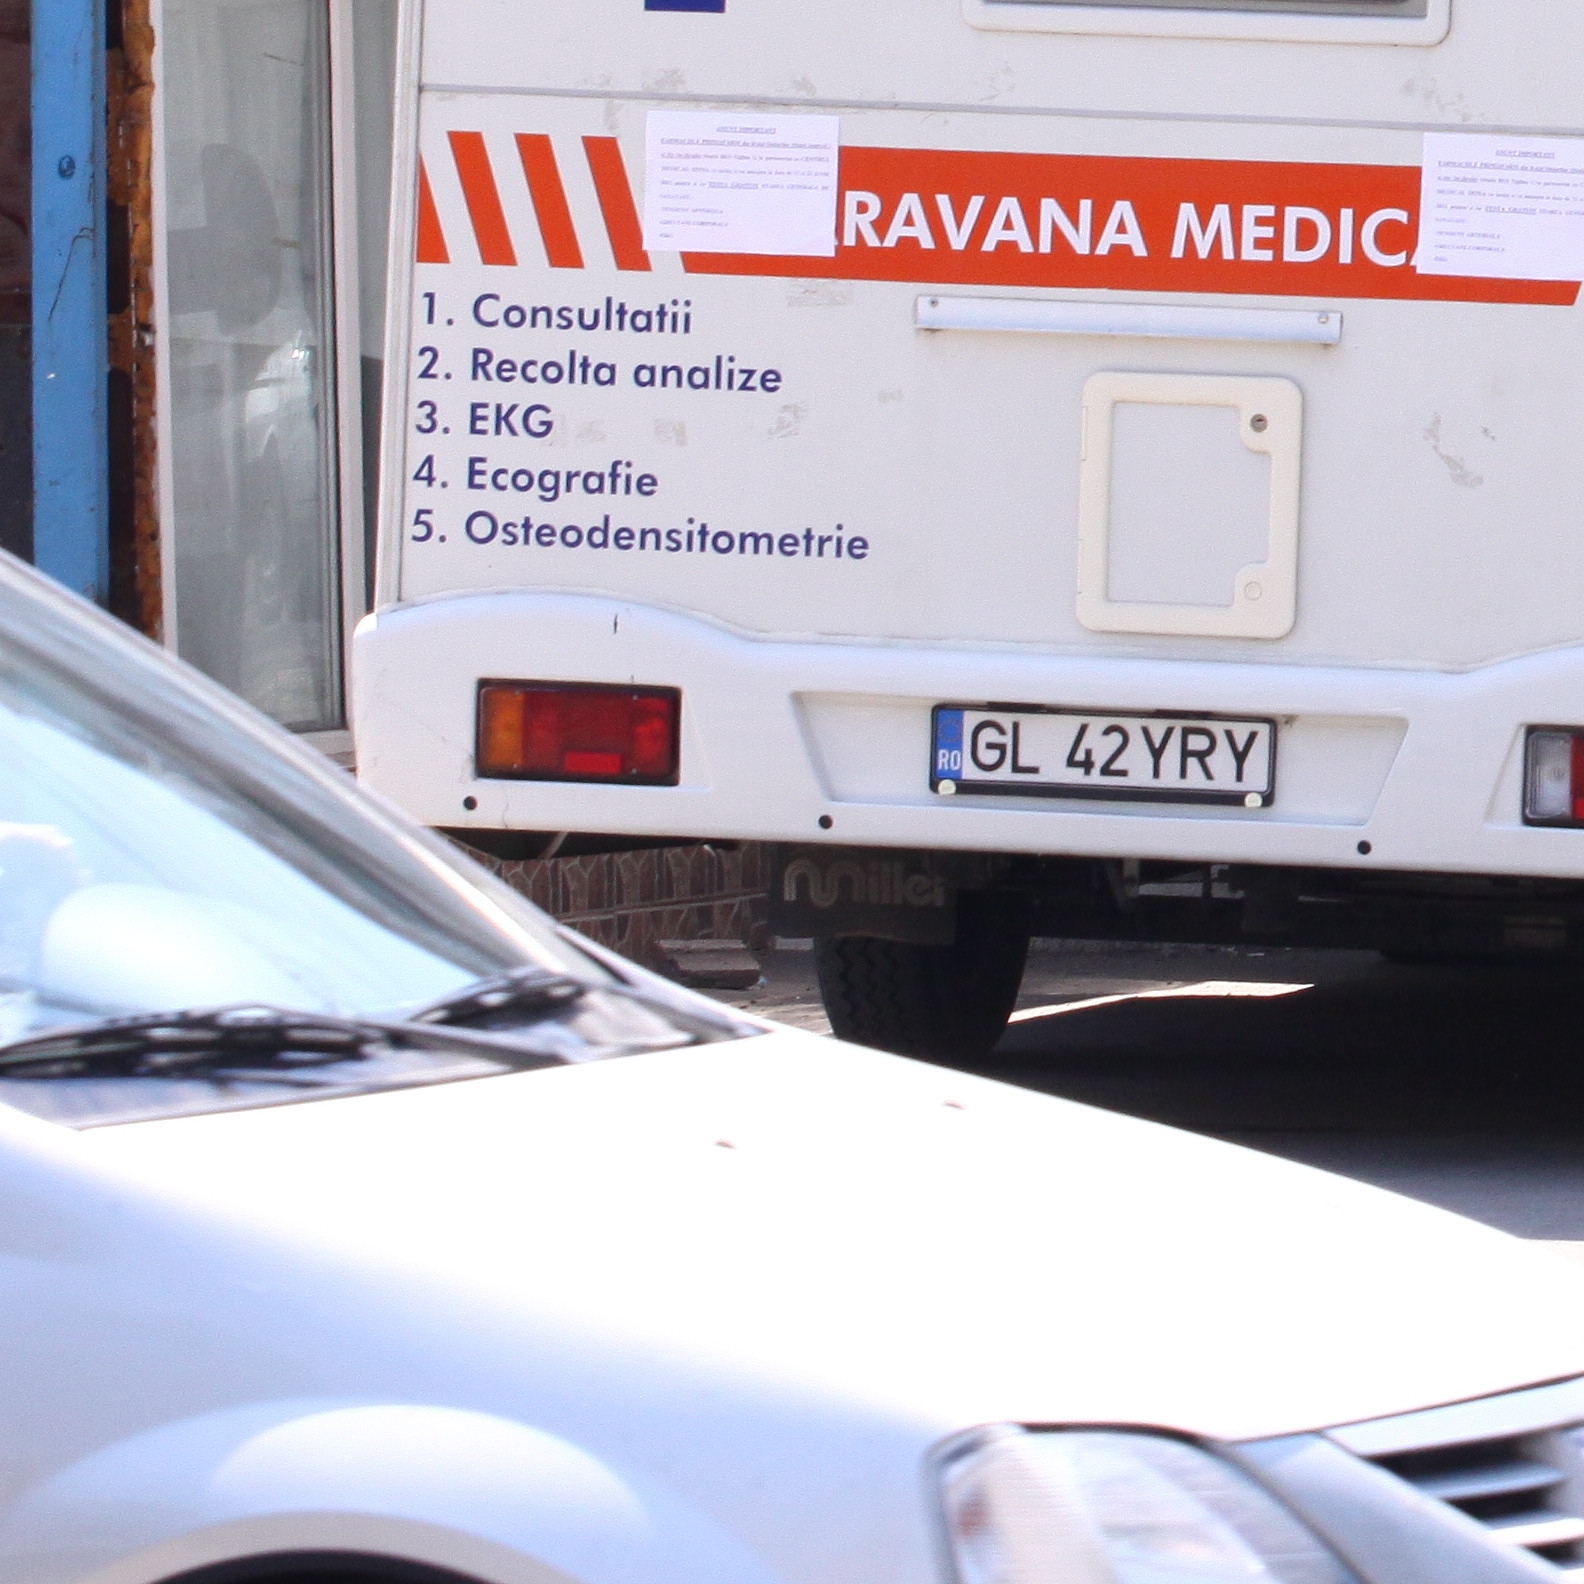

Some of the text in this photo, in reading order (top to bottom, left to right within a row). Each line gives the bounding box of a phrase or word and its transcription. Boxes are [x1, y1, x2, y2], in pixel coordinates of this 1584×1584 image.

[838, 191, 1147, 257] RAVANA
[1171, 202, 1416, 268] MEDIC
[422, 292, 692, 335] 1. Consultatii
[416, 347, 783, 393] 2. Recolta analize
[415, 402, 554, 439] 3. EKG
[413, 455, 660, 503] 4. Ecografie
[410, 510, 869, 560] 5. Osteodensitometrie
[937, 749, 960, 771] RO
[970, 720, 1040, 774] GL
